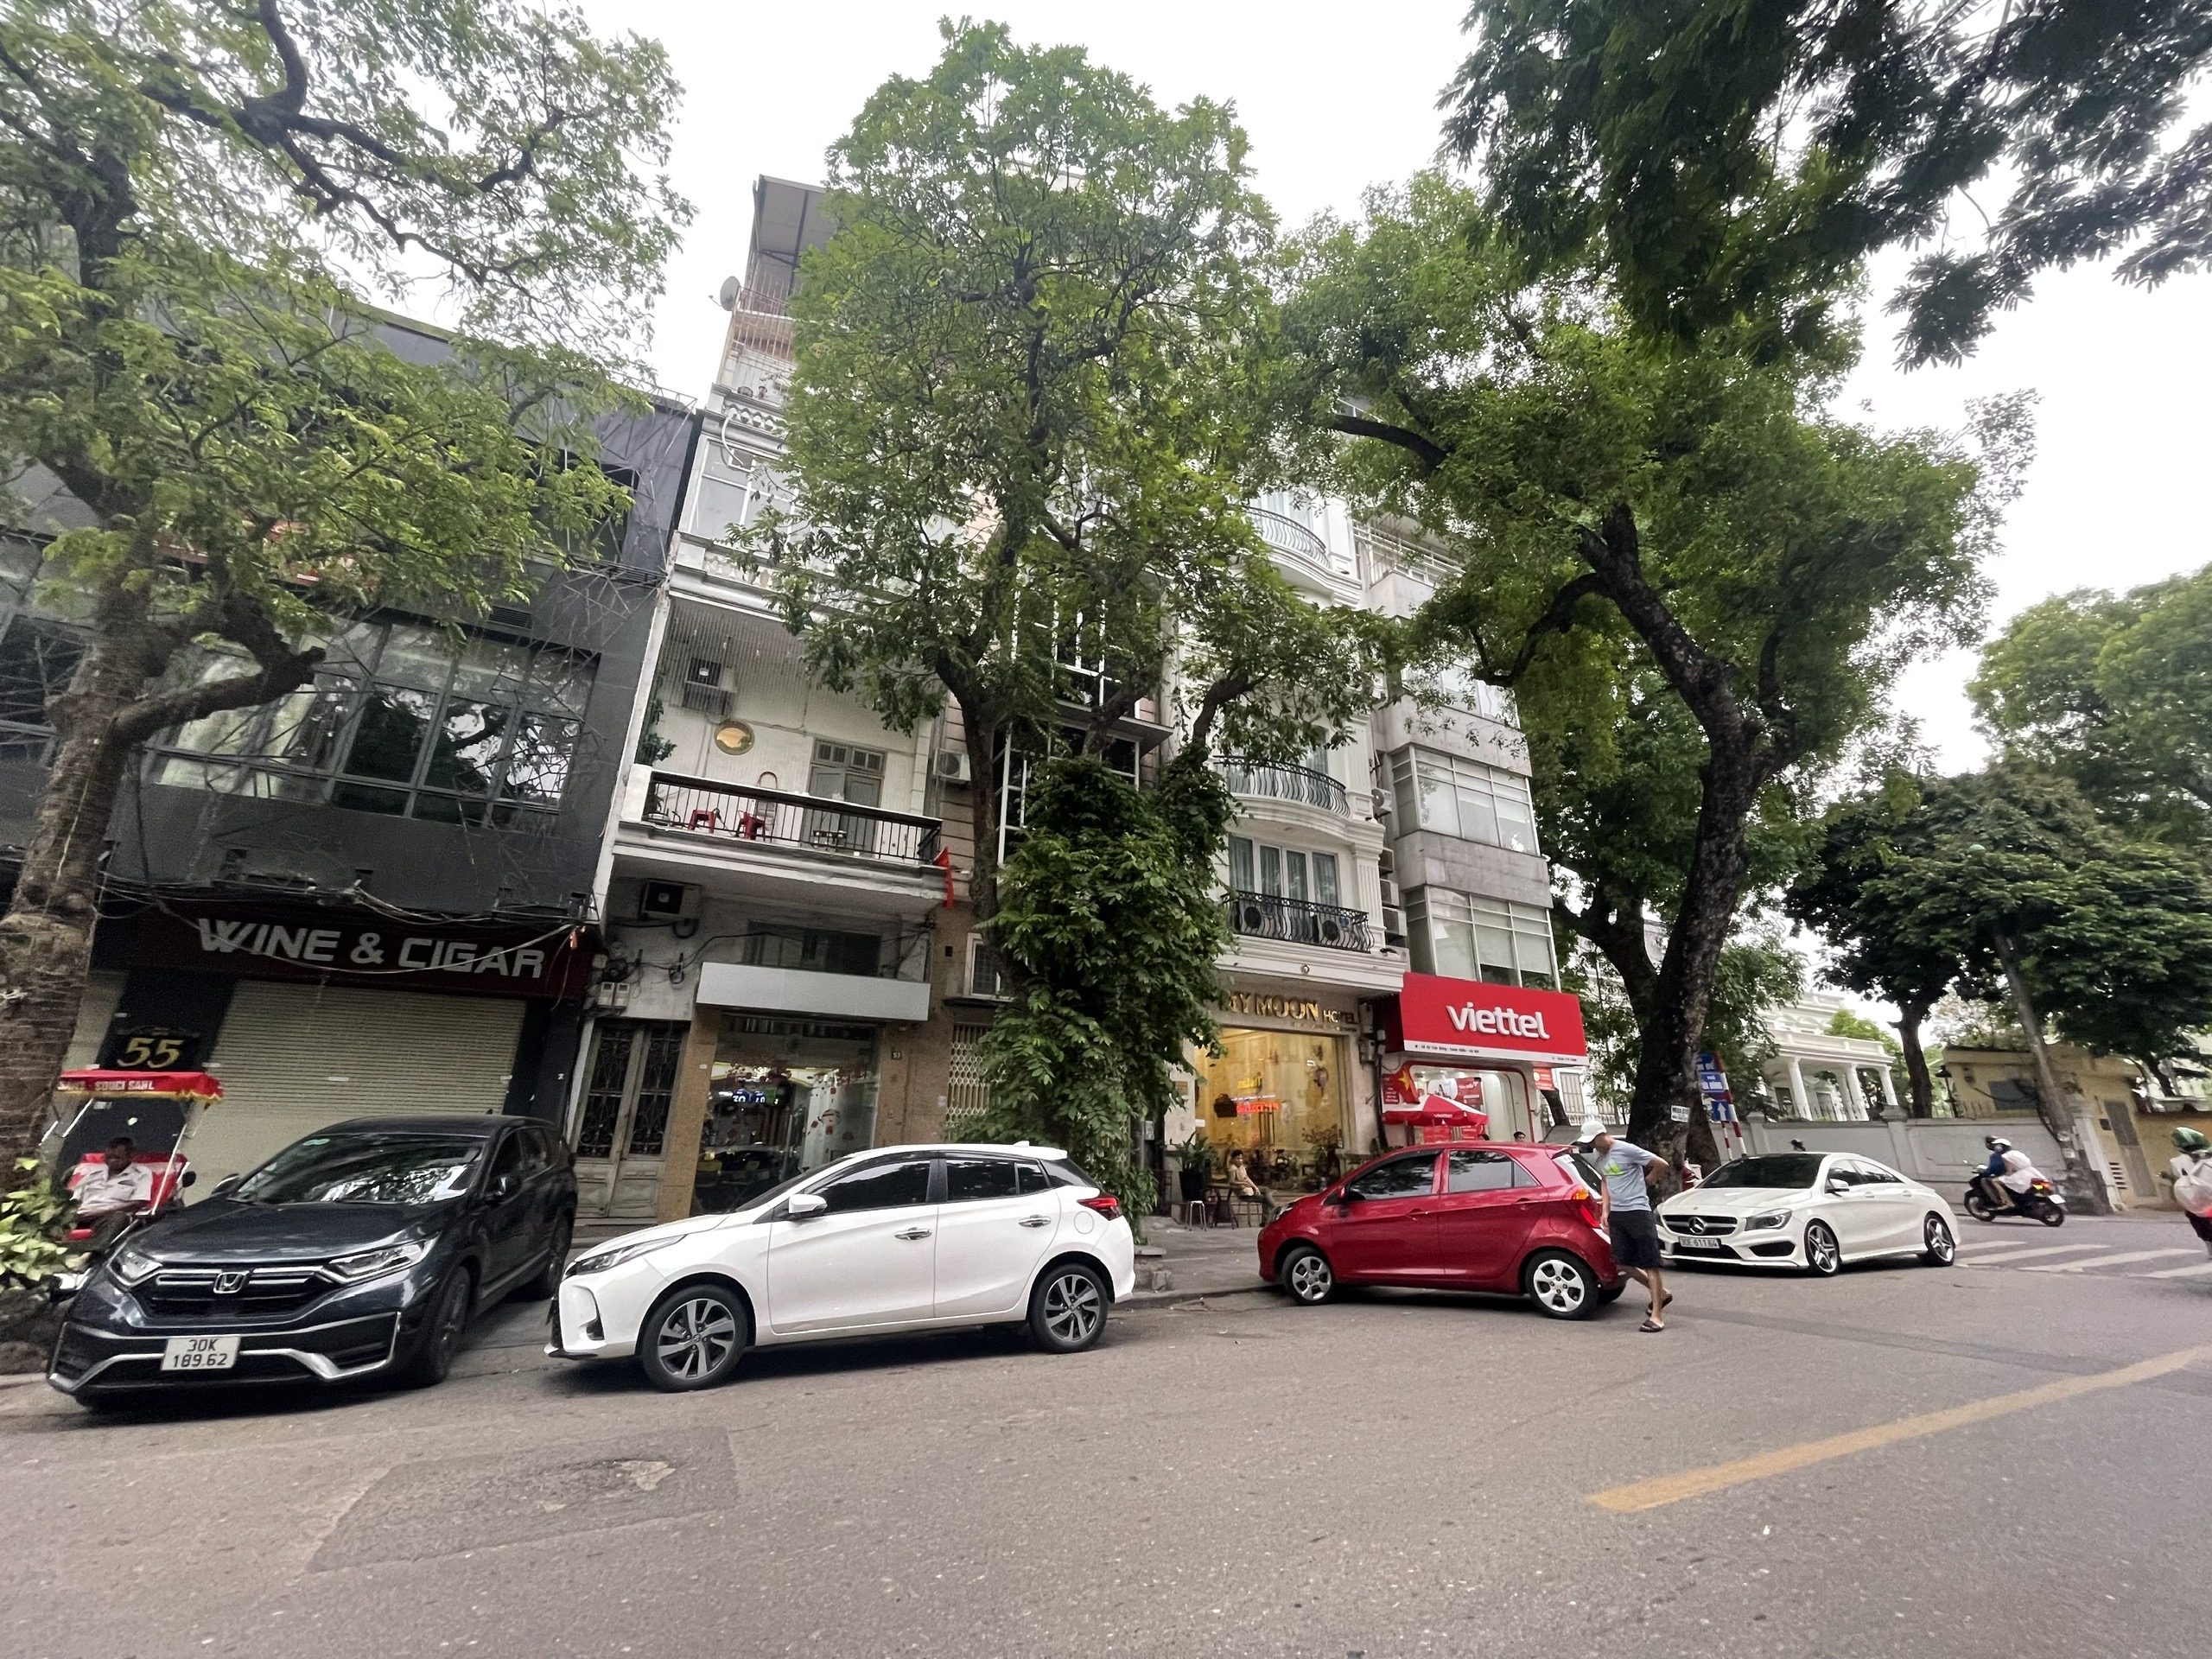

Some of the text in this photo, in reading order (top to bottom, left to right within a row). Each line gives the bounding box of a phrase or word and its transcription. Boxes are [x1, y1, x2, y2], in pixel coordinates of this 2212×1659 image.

[198, 918, 545, 979] WINE & CIGAR
[1255, 993, 1319, 1021] MOON
[1446, 1001, 1550, 1039] viettel
[118, 1037, 184, 1069] 55
[187, 1338, 219, 1352] 30K
[173, 1353, 228, 1368] 189.62
